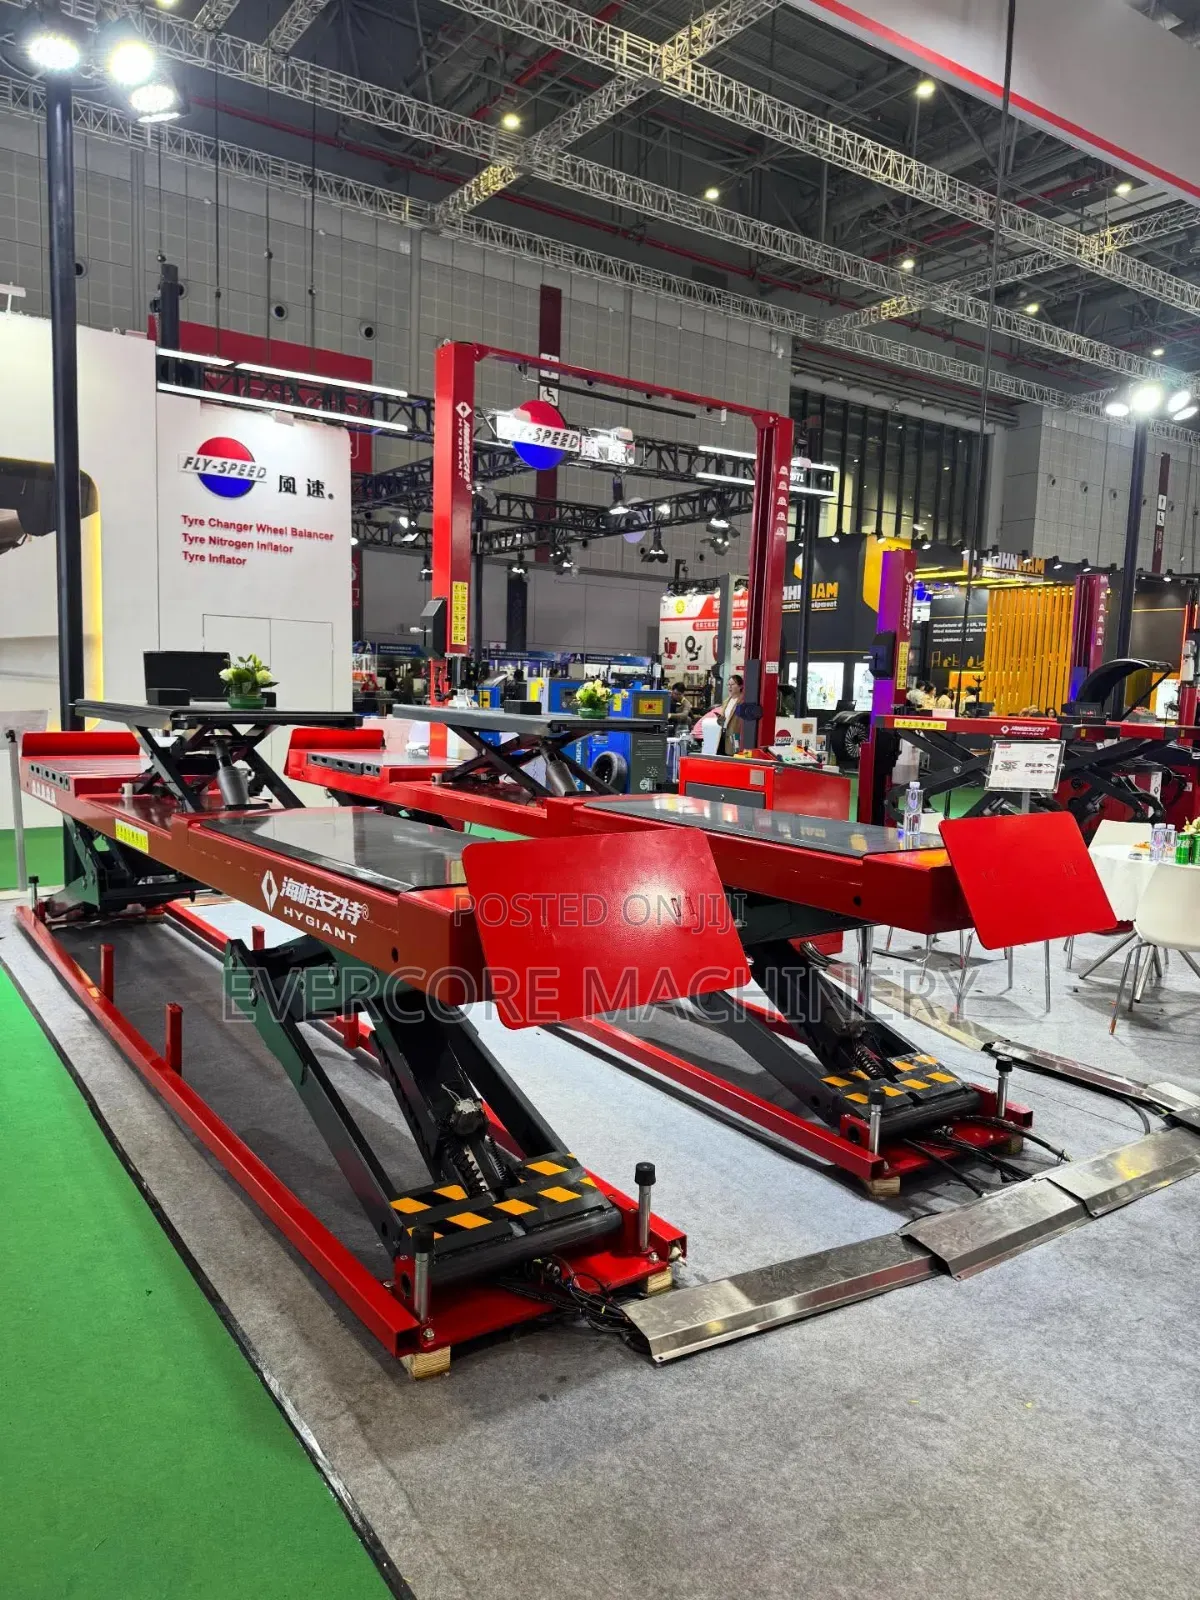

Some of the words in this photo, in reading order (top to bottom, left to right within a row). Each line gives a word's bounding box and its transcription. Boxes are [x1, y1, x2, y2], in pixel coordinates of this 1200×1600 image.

[183, 456, 267, 479] FLY-SPEED
[181, 515, 205, 527] Tyre
[208, 518, 253, 533] Changer
[256, 523, 288, 535] Wheel
[291, 527, 334, 541] Balancer
[182, 533, 206, 545] Tyre
[209, 536, 254, 551] Nitrogen
[257, 541, 294, 553] Inflator
[182, 551, 206, 563] Tyre
[208, 553, 247, 566] Inflator
[284, 906, 358, 944] HYGIANT
